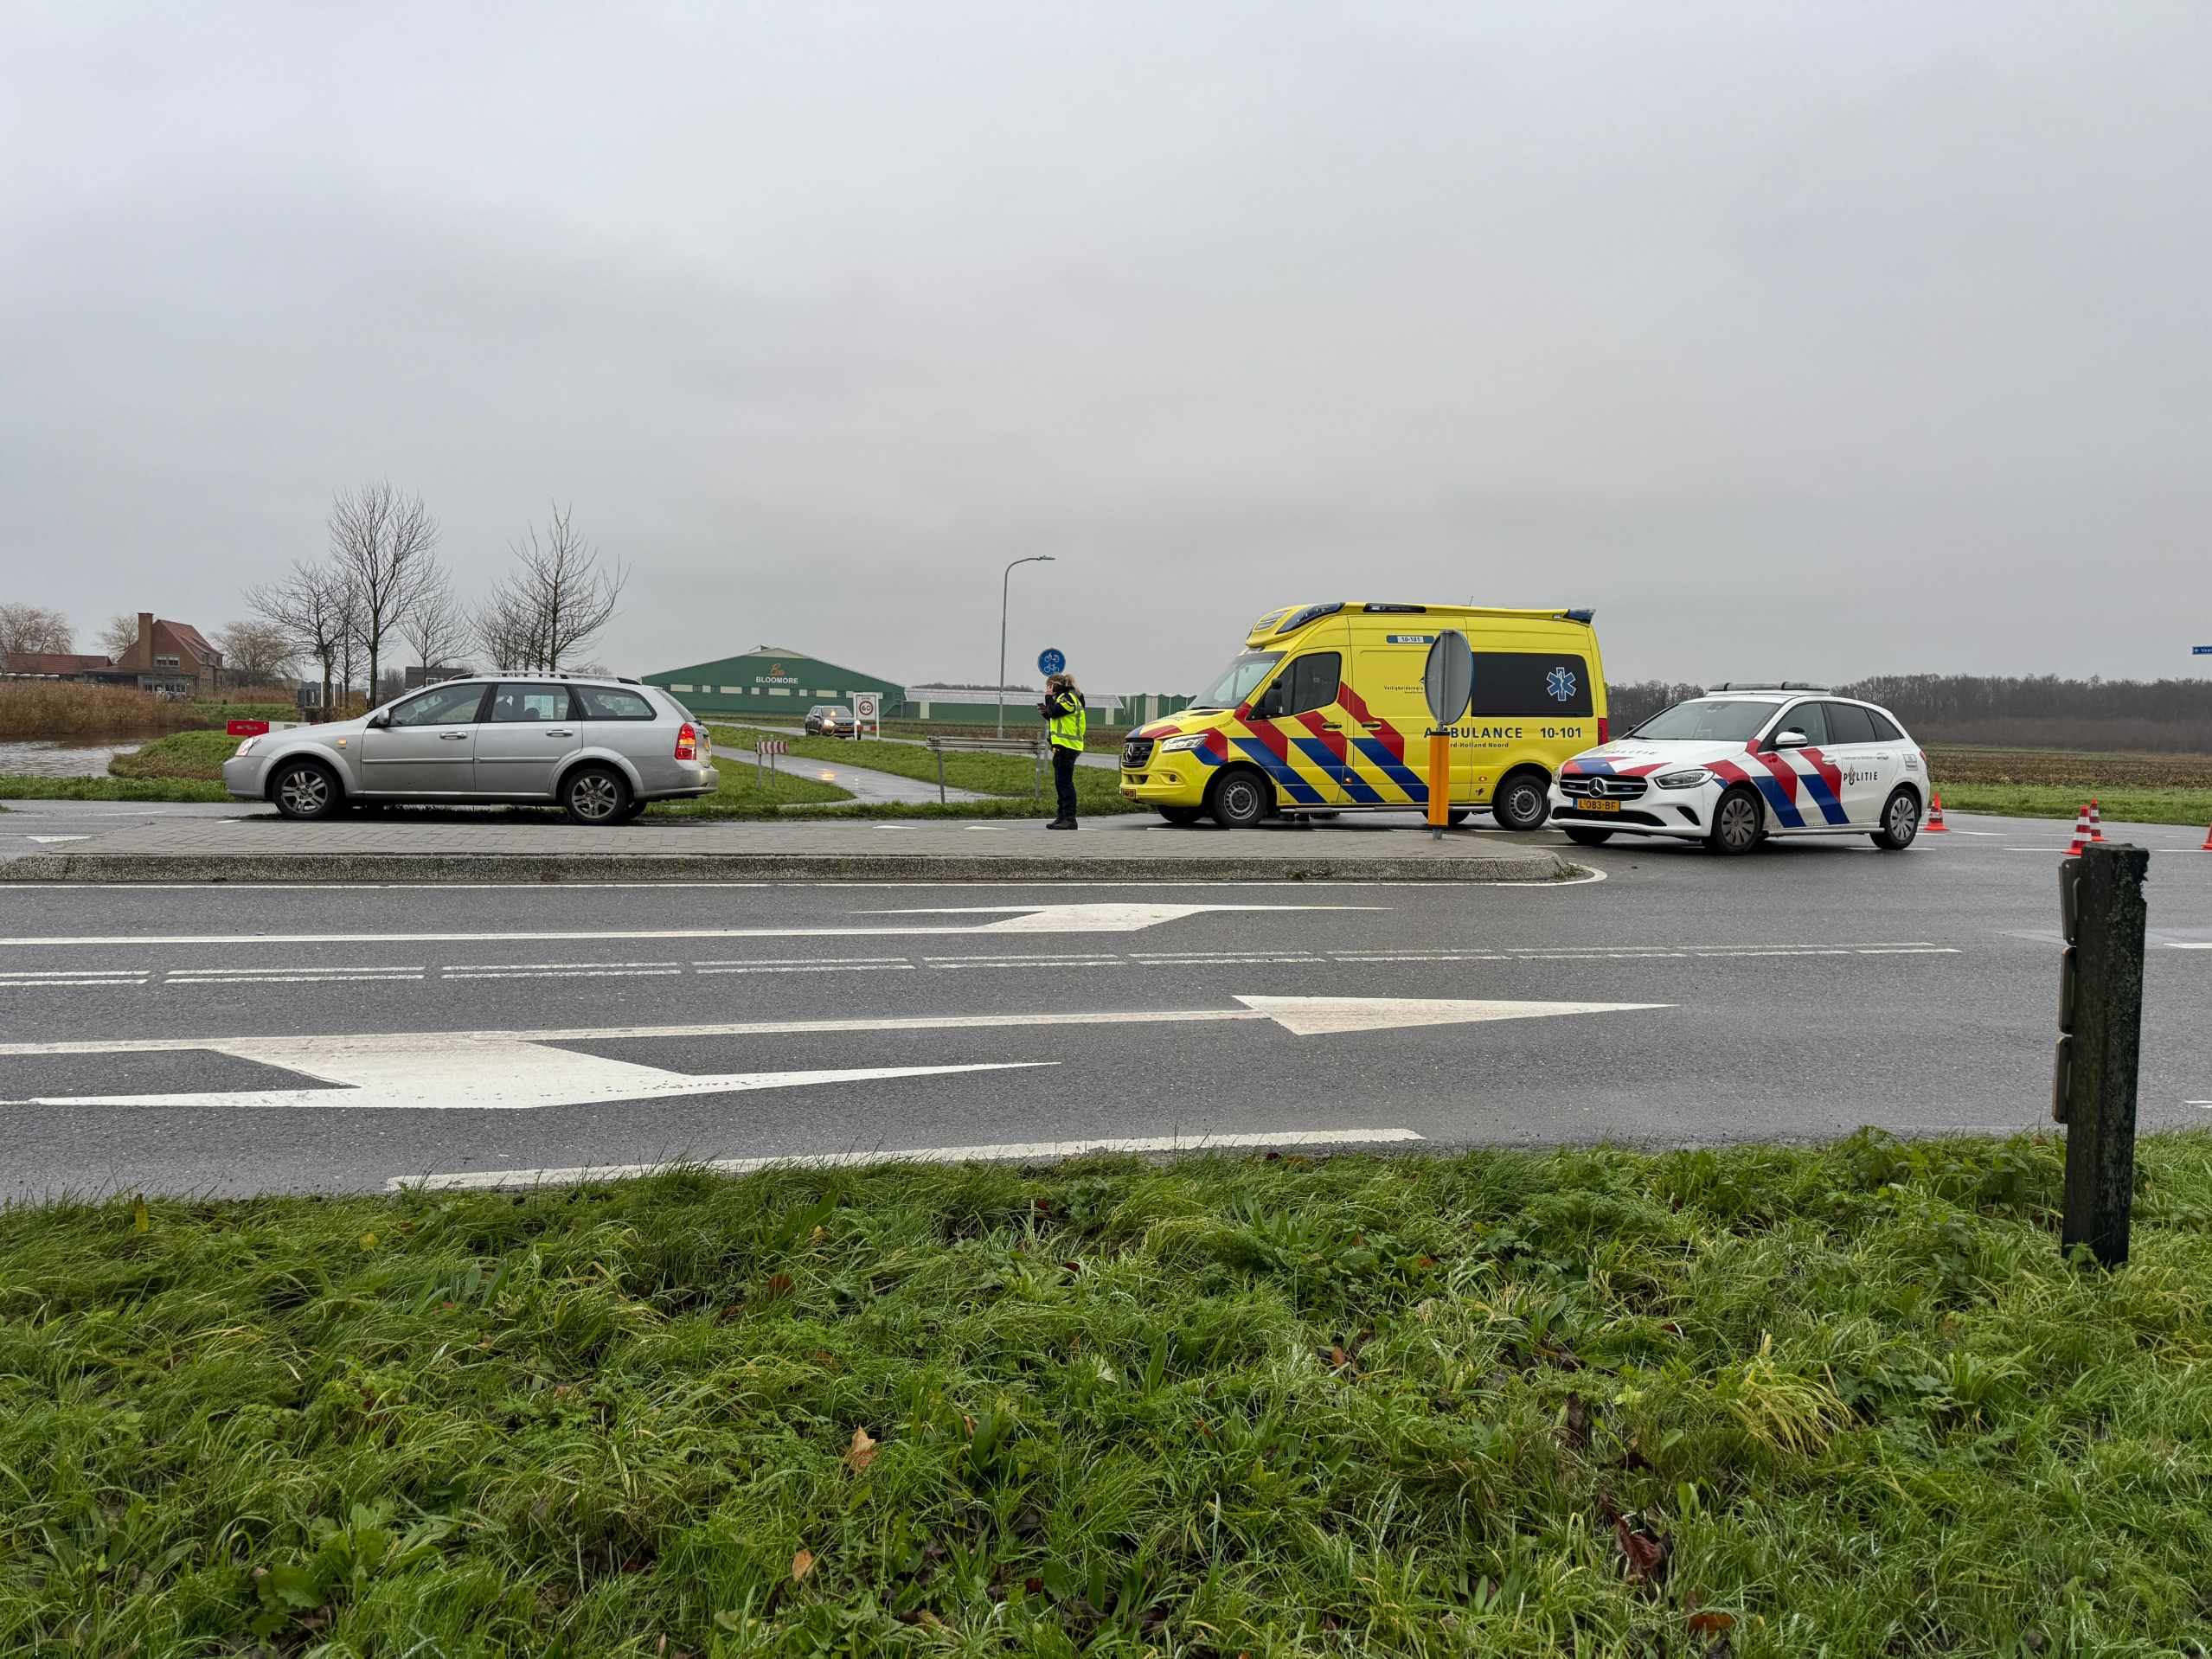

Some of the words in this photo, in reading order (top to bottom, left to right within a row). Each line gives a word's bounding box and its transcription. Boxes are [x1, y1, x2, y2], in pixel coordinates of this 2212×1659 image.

[1424, 727, 1523, 739] ABULANCE
[1540, 727, 1581, 739] 10-101
[1843, 770, 1878, 785] POLITIE
